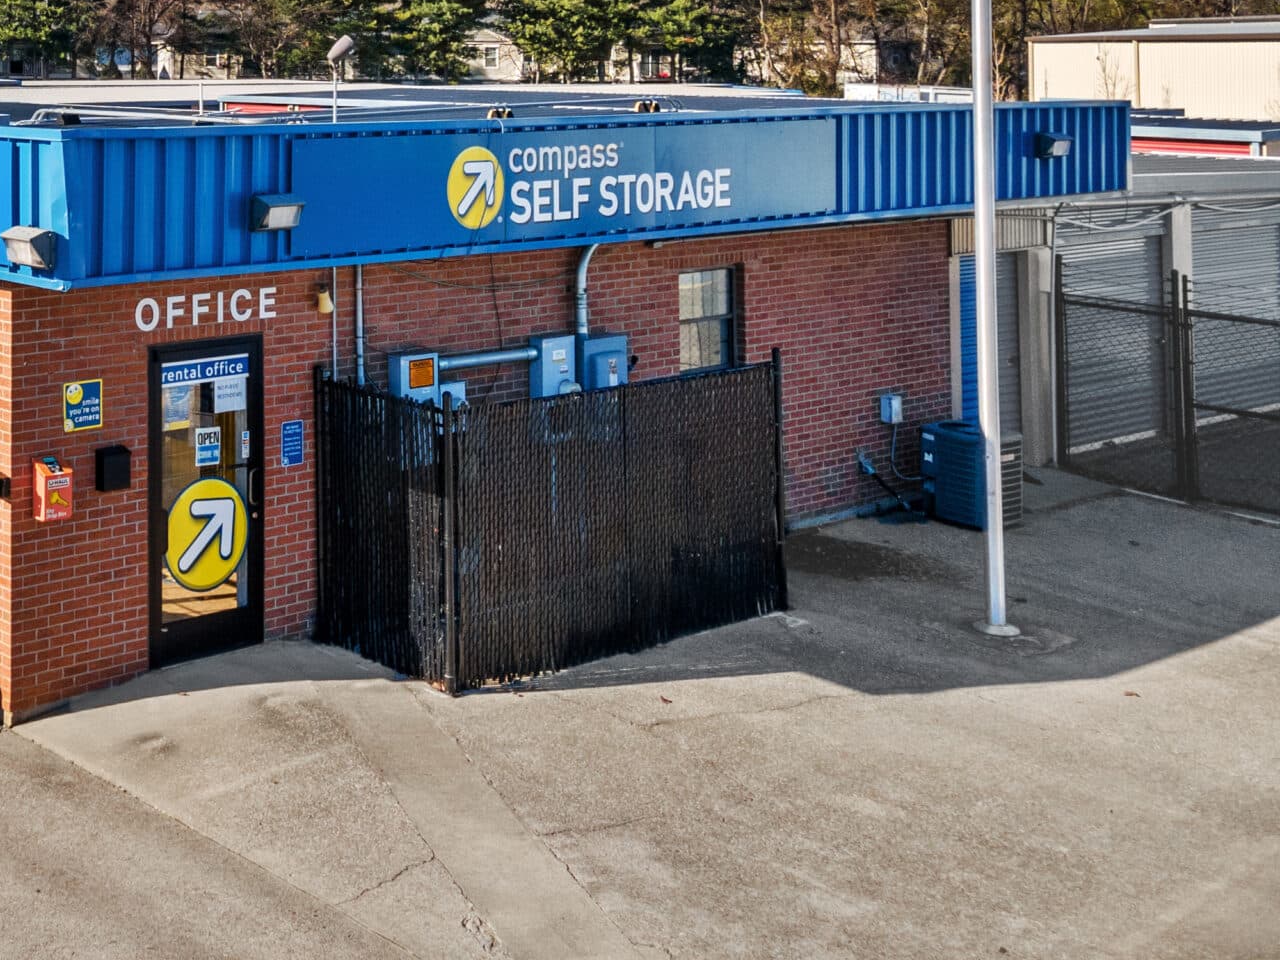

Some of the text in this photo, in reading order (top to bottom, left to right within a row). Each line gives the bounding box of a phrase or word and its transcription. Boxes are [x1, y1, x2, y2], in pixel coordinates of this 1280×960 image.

[508, 143, 619, 177] compass
[509, 168, 732, 224] SELF STORAGE
[134, 287, 278, 332] OFFICE
[161, 360, 244, 383] rental office
[82, 397, 100, 406] smile
[74, 413, 100, 423] camera
[197, 431, 220, 446] OPEN
